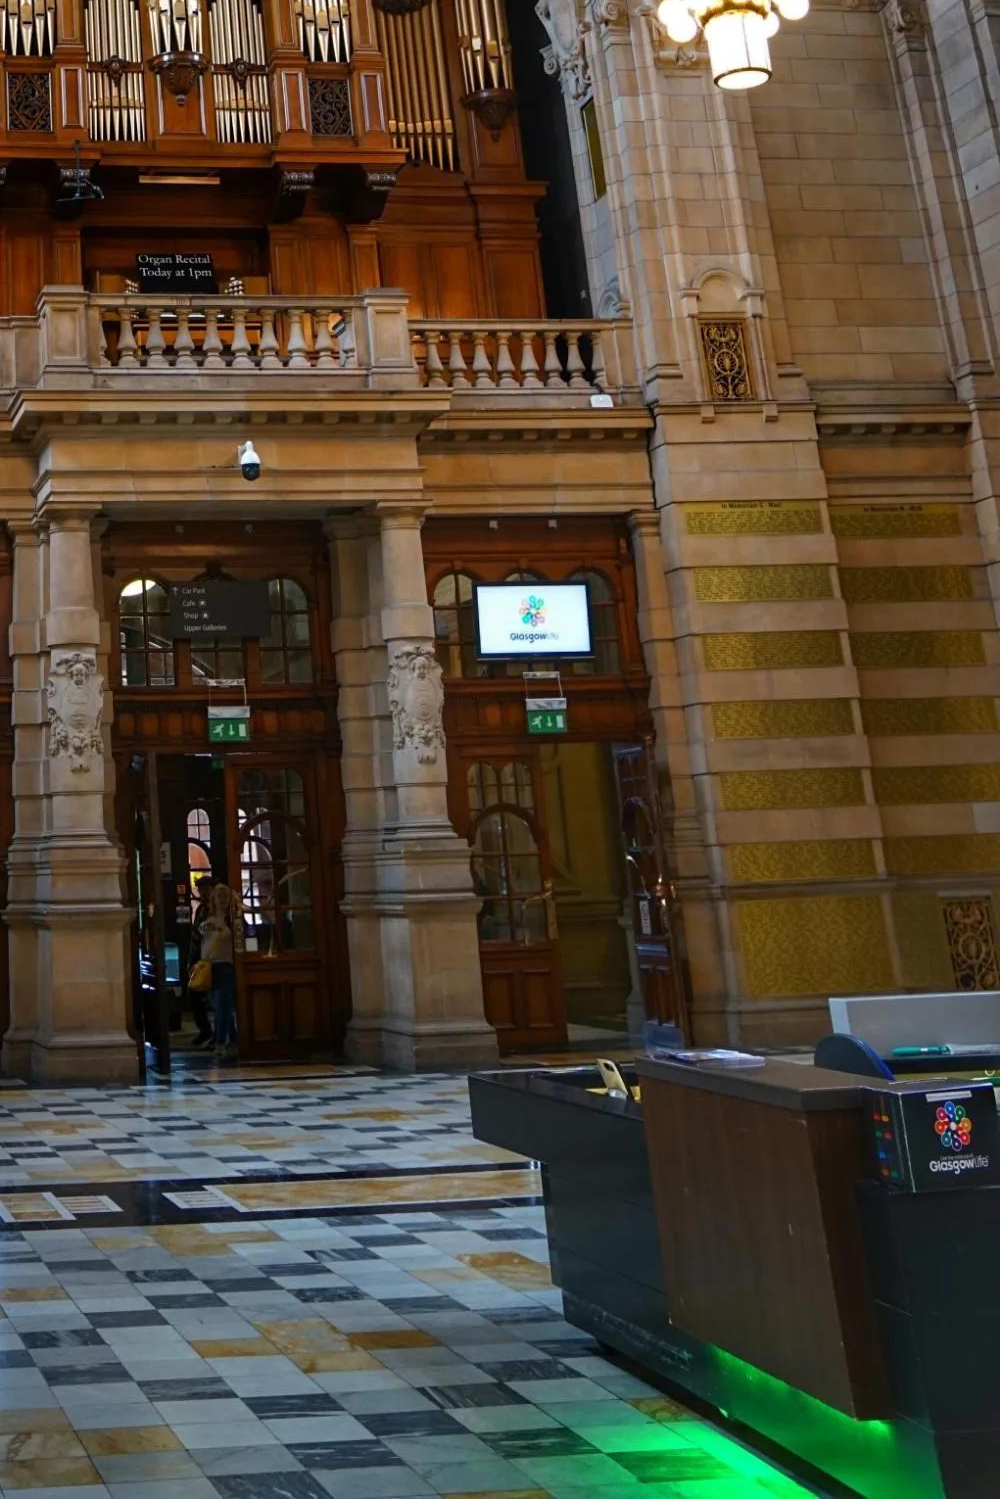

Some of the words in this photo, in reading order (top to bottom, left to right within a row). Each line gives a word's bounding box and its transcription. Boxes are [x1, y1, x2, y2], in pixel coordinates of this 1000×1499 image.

[138, 254, 173, 266] Organ
[175, 254, 211, 264] Recital
[139, 267, 172, 280] Today
[175, 269, 185, 277] at
[189, 267, 212, 280] 1pm
